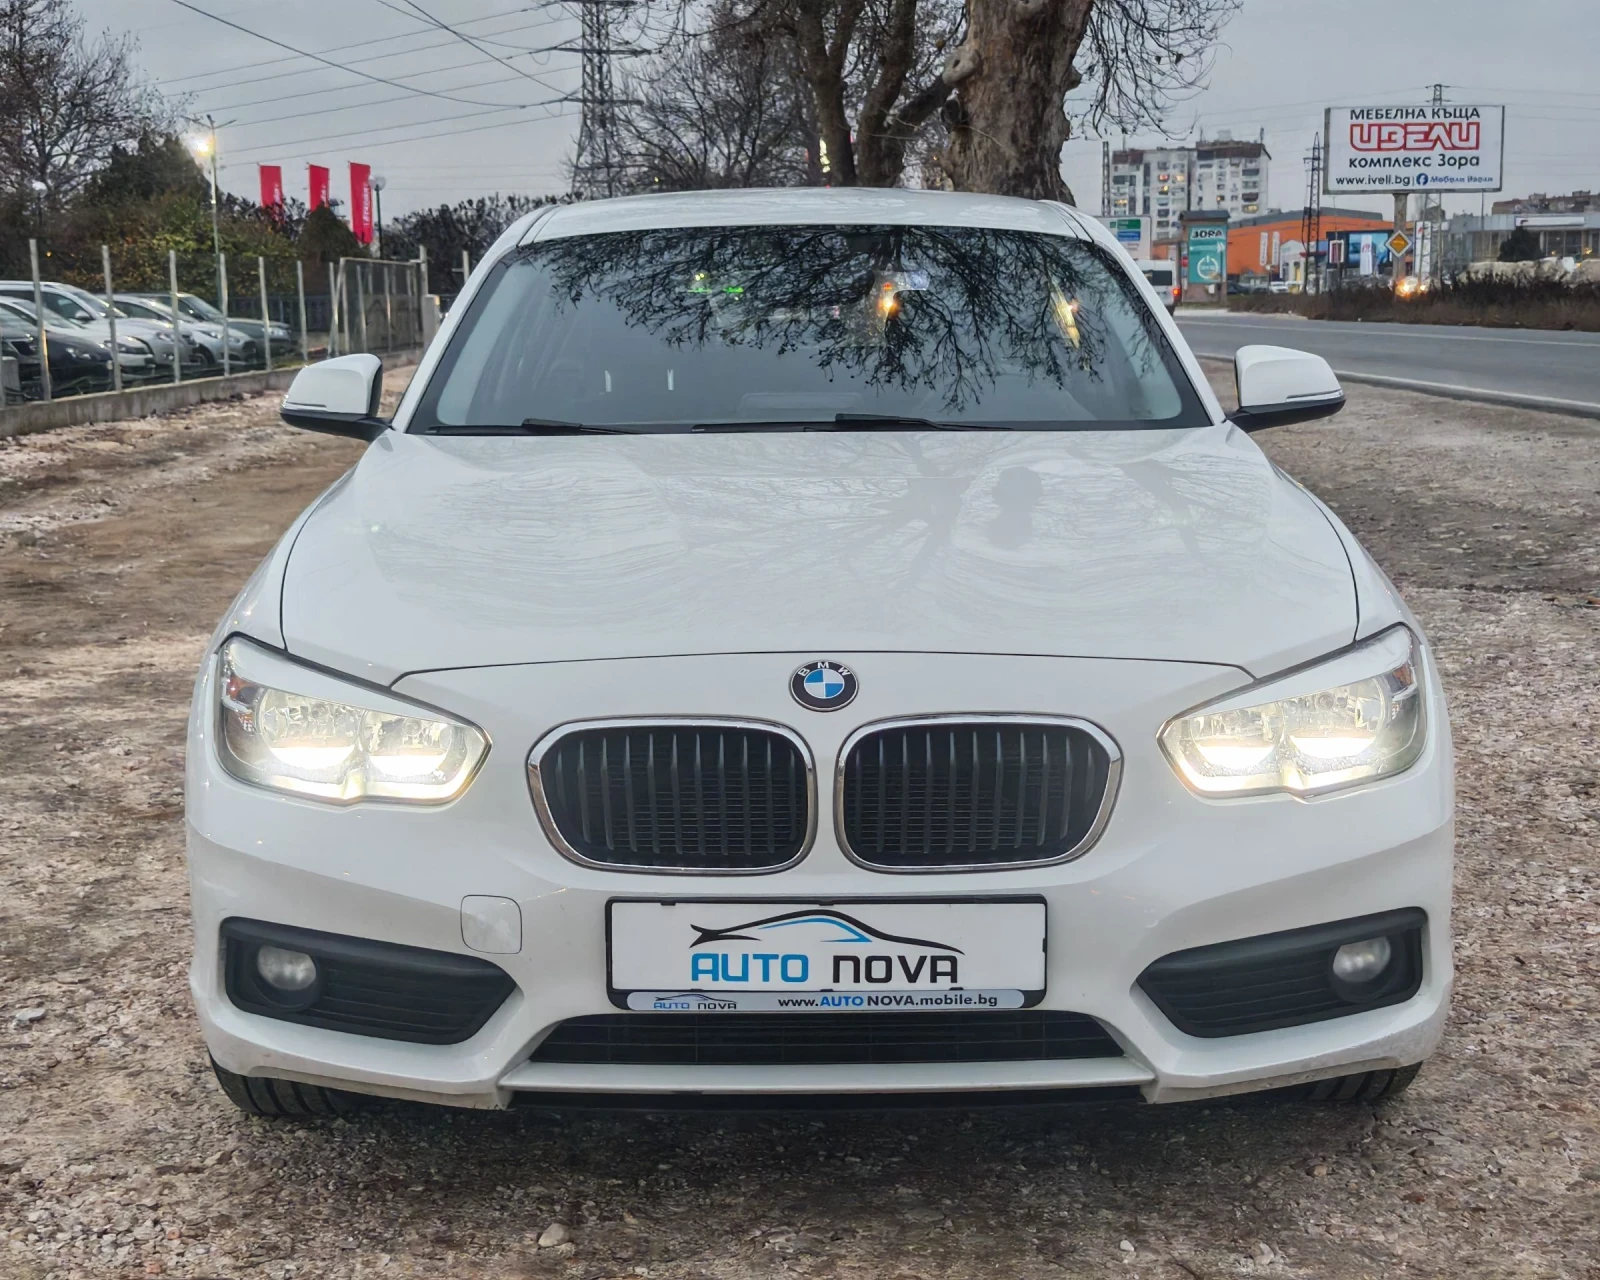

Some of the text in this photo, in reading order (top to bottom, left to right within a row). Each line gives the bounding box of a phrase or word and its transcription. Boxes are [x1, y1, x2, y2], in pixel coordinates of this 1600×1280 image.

[1350, 107, 1480, 121] МЕБЕЛНА КЪЩА
[1349, 153, 1479, 169] комплекс Зора
[1336, 175, 1410, 186] www.iveli.bg
[798, 661, 851, 677] BMW
[691, 953, 959, 984] AUTO NOVA
[653, 1002, 737, 1010] AUTO NOVA
